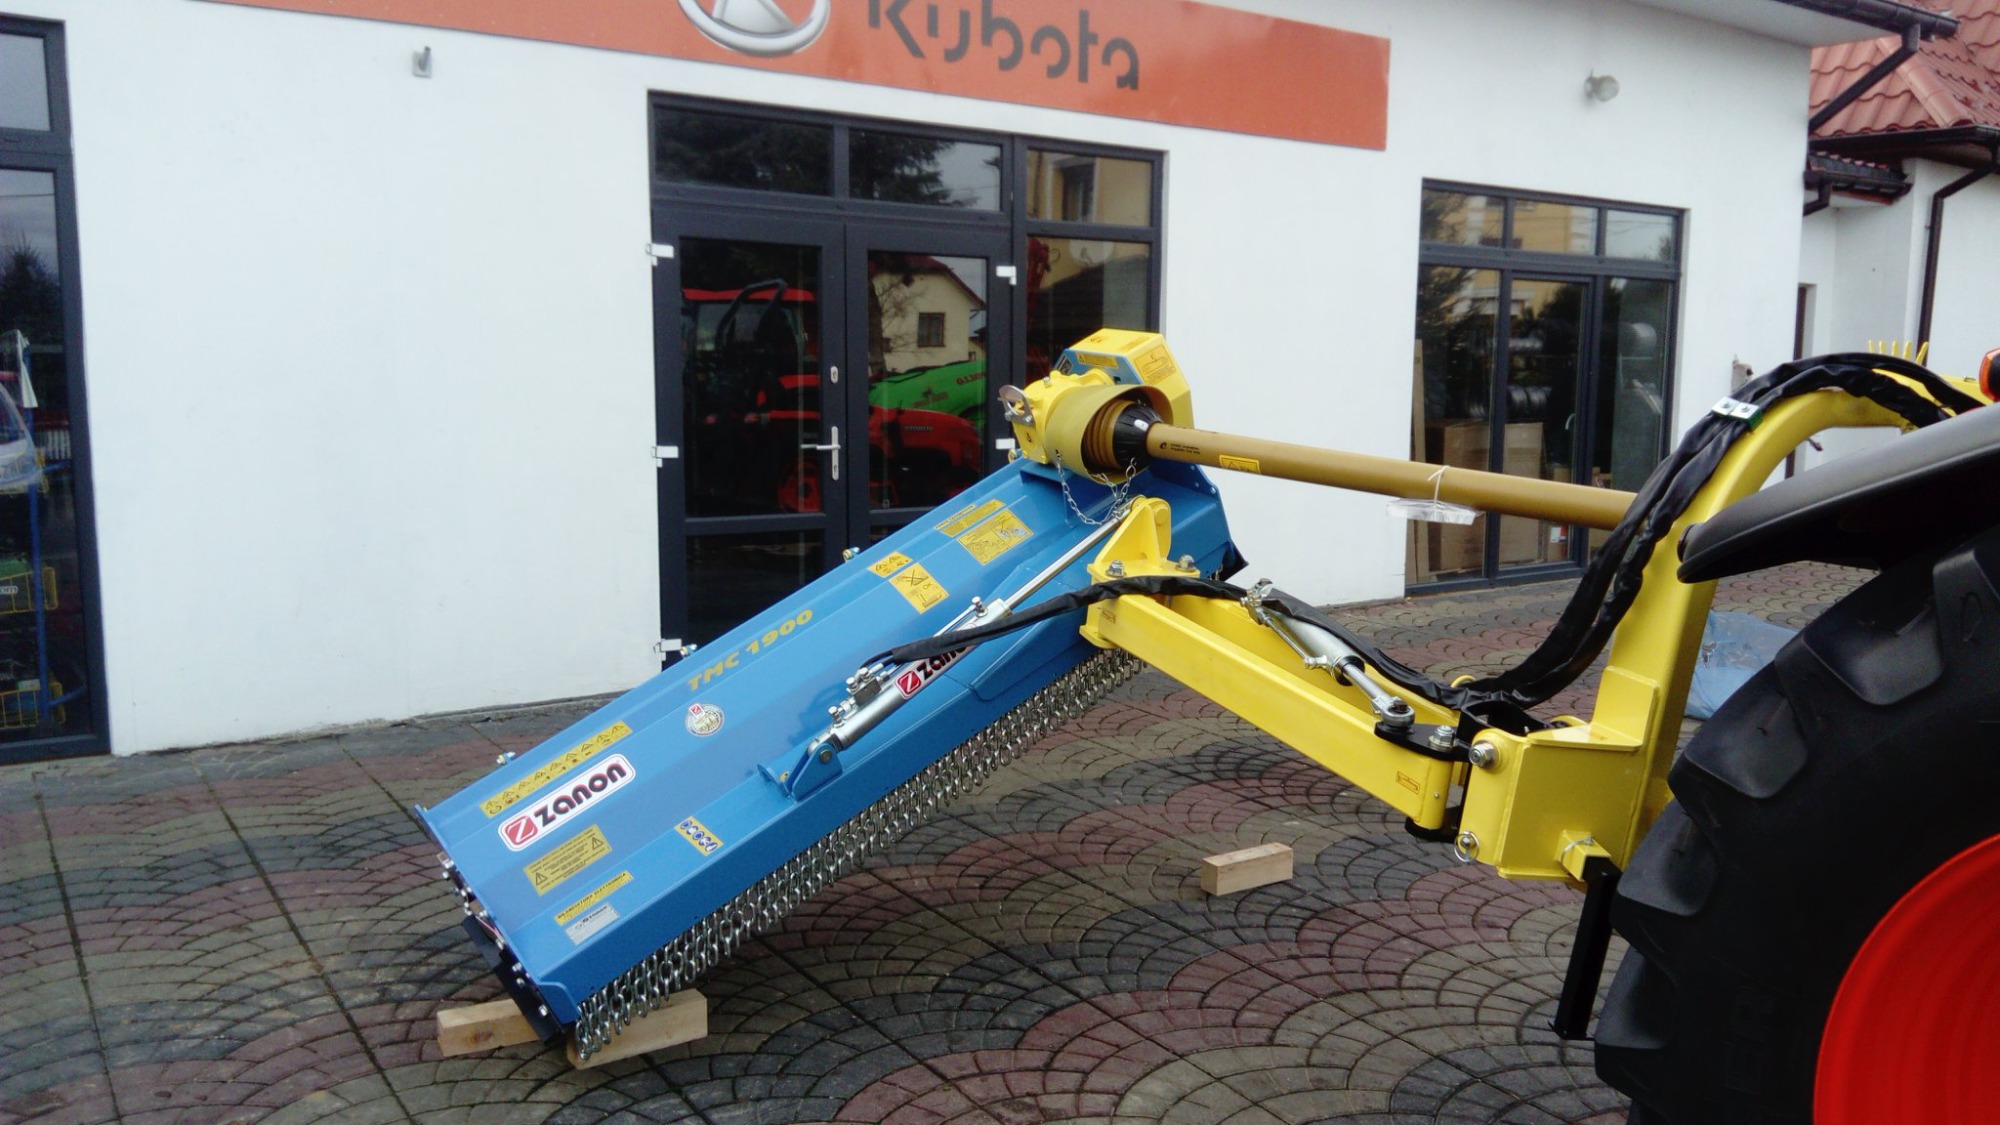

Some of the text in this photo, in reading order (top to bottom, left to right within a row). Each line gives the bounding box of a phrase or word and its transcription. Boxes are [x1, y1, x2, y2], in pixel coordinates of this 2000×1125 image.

[868, 0, 1139, 91] Kubota
[688, 609, 813, 691] TMC 1900
[917, 647, 967, 681] zan
[534, 762, 627, 827] zanon
